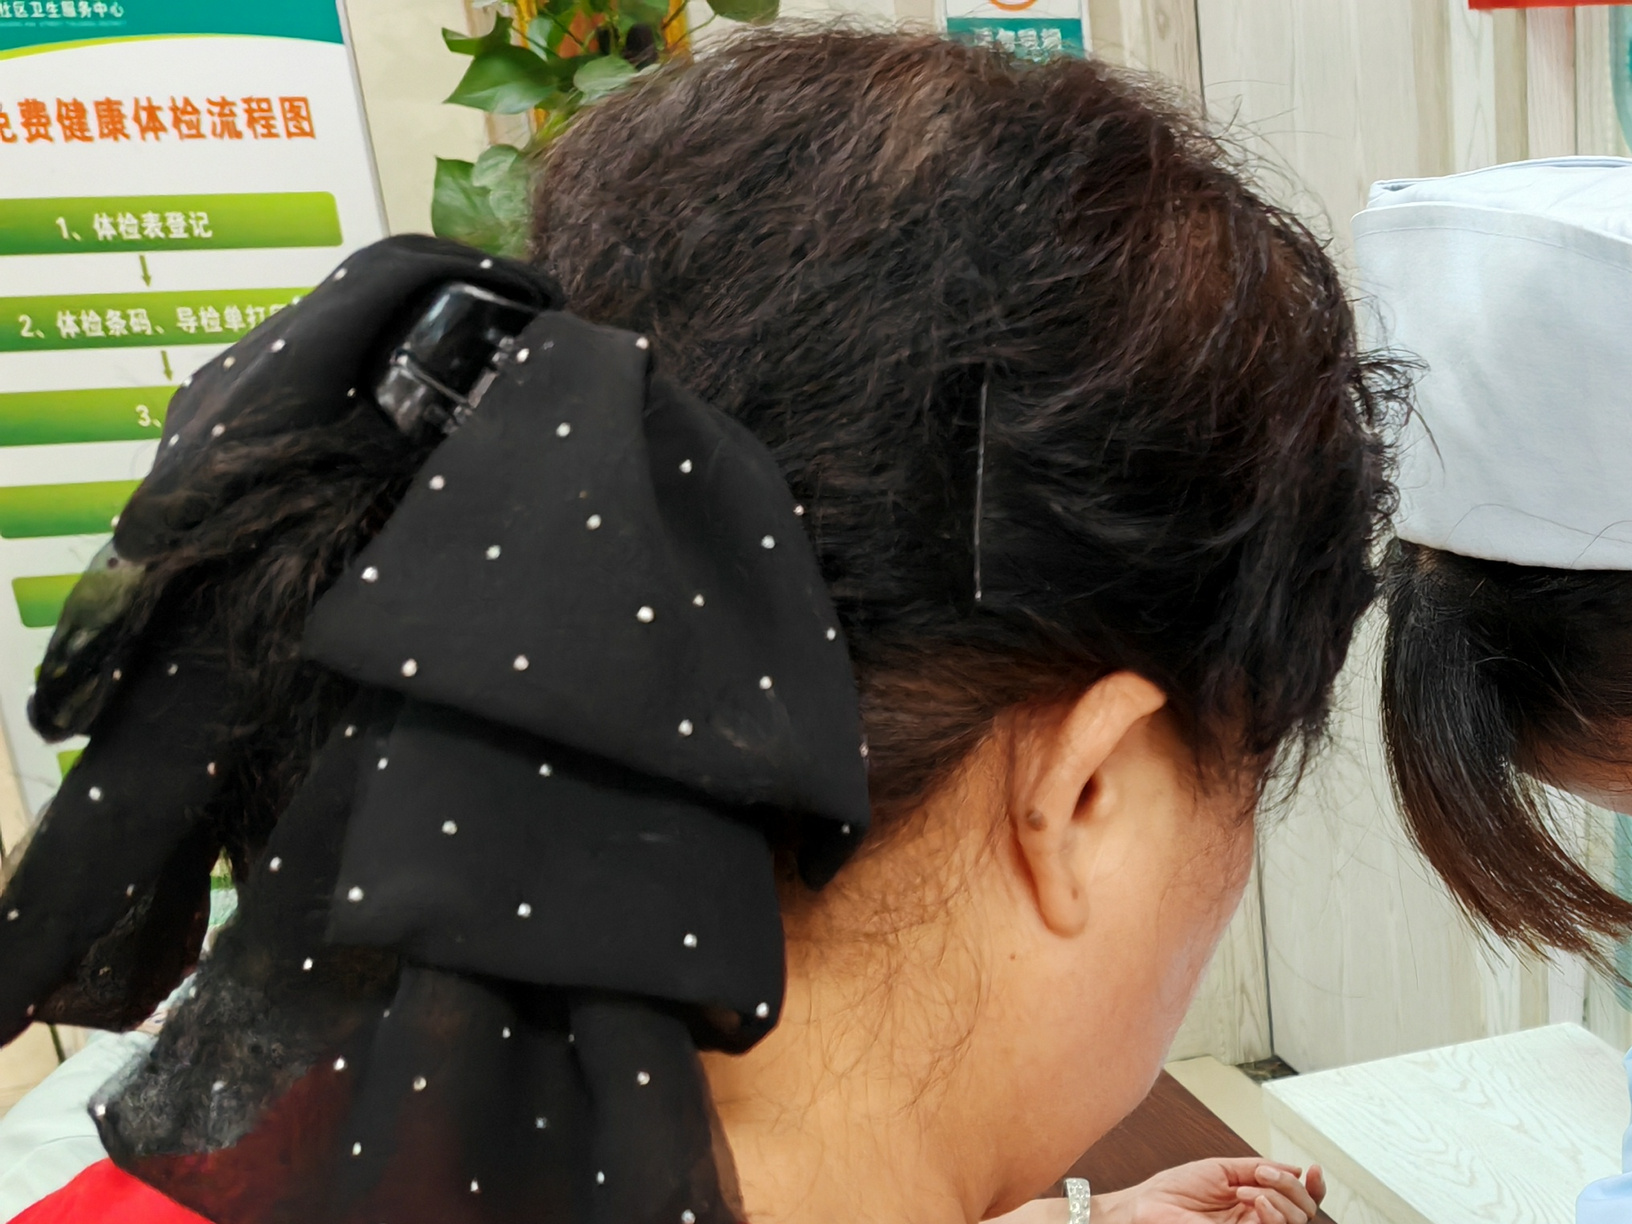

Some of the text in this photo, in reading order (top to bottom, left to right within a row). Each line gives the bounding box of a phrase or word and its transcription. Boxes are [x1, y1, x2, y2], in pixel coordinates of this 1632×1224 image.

[56, 212, 213, 241] 1、体检表登记
[19, 303, 288, 340] 2、体检条码、导检单打
